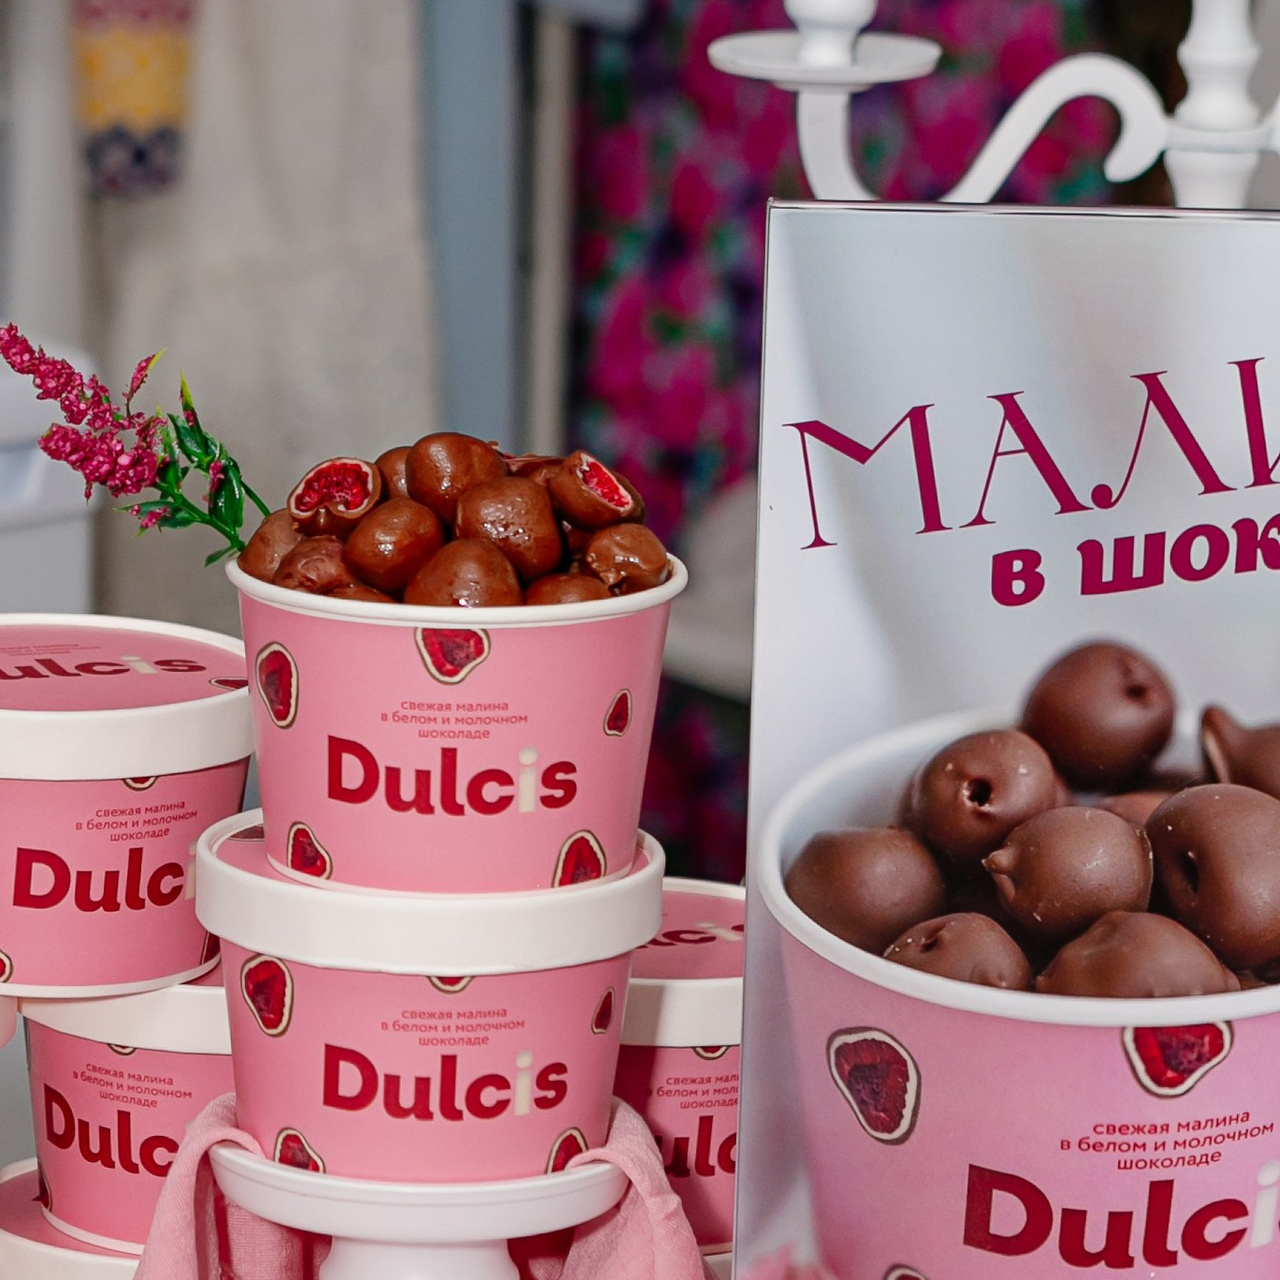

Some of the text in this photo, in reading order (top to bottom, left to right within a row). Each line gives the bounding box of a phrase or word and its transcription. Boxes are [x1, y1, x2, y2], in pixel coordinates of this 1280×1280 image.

[991, 548, 1046, 607] в
[401, 700, 509, 712] свежая малина
[381, 711, 528, 725] в белом и молочном
[418, 728, 490, 739] шоколаде
[328, 734, 578, 816] Dulcis
[95, 801, 186, 818] свежая малина
[75, 809, 198, 831] в белом и молочном
[110, 827, 170, 842] шоколаде
[13, 847, 197, 912] Dulci
[401, 1008, 508, 1020] свежая малина
[381, 1019, 525, 1033] в белом и молочном
[419, 1035, 489, 1046] шоколаде
[86, 1063, 173, 1086] свежая малина
[323, 1043, 568, 1121] Dulcis
[666, 1076, 712, 1085] свежая
[73, 1071, 192, 1099] в белом и молочном
[656, 1086, 698, 1097] белом
[99, 1090, 158, 1108] шоколаде
[44, 1083, 179, 1177] Dulc
[1093, 1111, 1250, 1136] свежая малина
[1060, 1122, 1274, 1153] в белом и молочном
[1117, 1151, 1222, 1171] шоколаде
[963, 1160, 1280, 1269] Dulci
